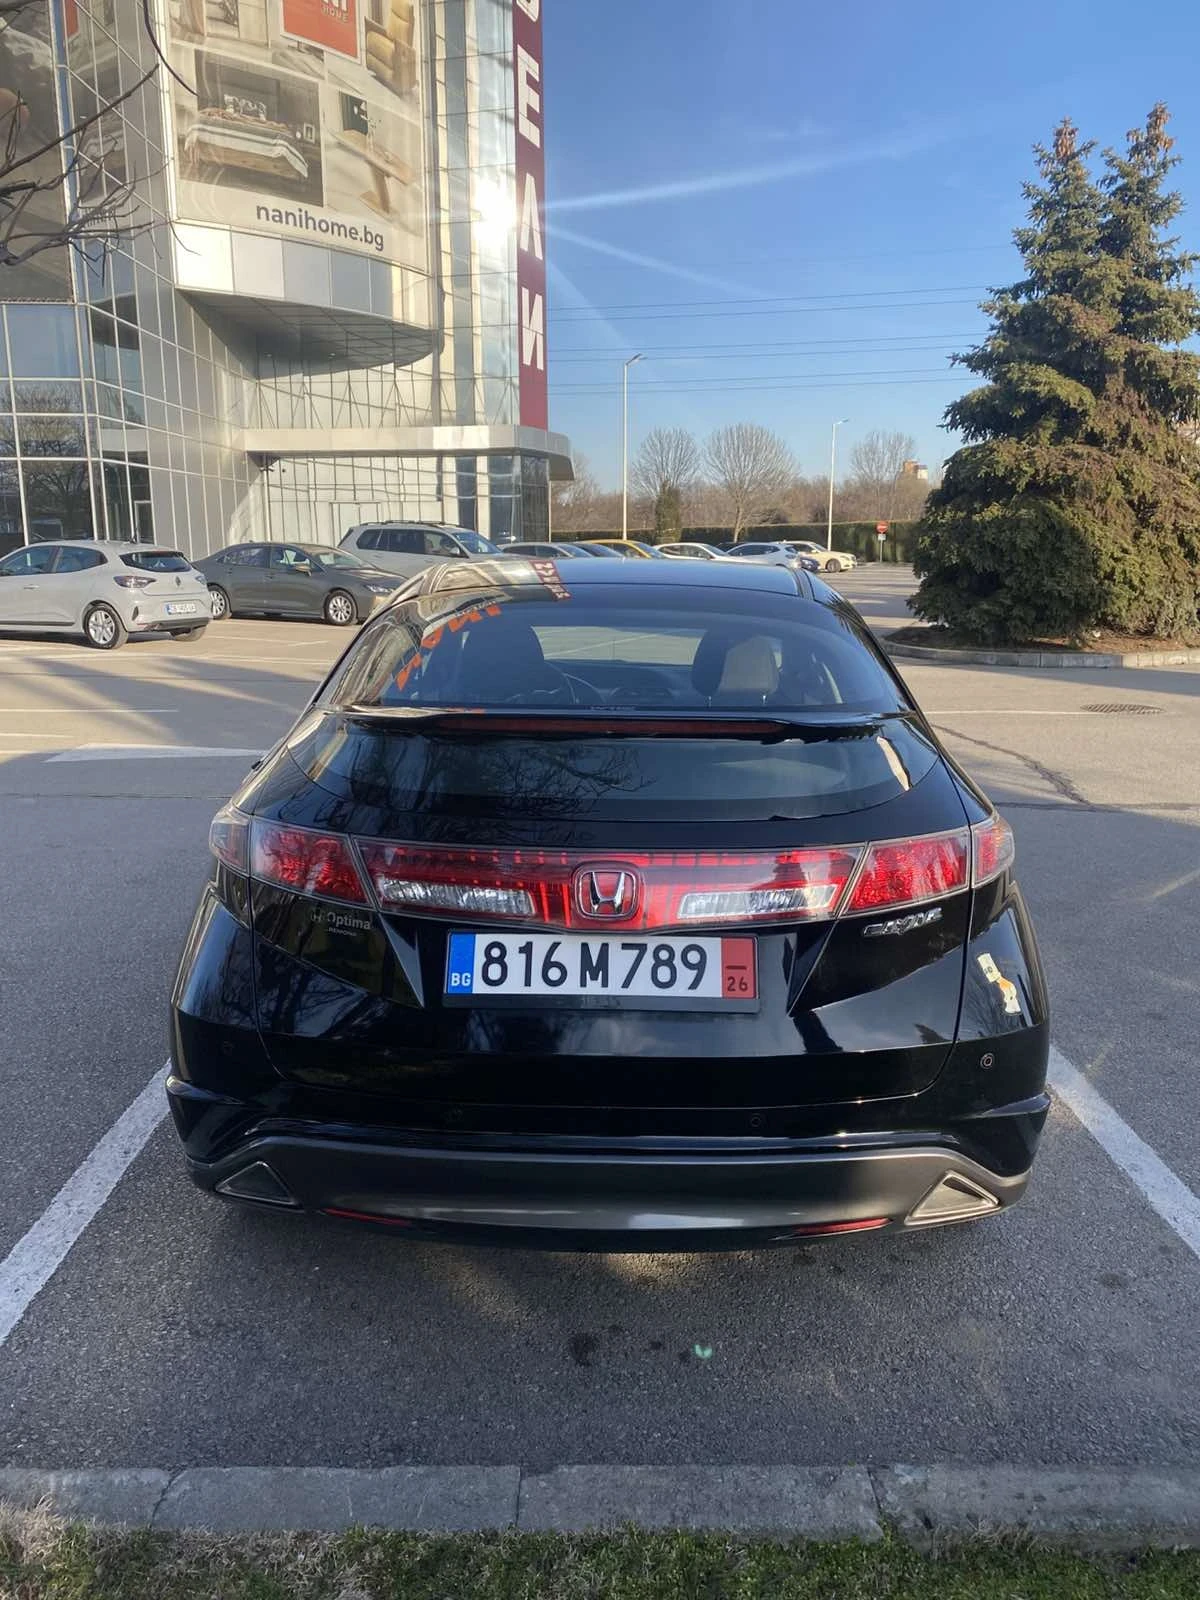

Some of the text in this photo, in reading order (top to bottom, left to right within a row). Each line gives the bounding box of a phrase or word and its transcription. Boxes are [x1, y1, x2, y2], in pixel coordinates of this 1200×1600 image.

[256, 205, 384, 251] nanihome.bg
[327, 911, 372, 930] Optima
[450, 972, 471, 987] BG
[726, 976, 749, 992] 26
